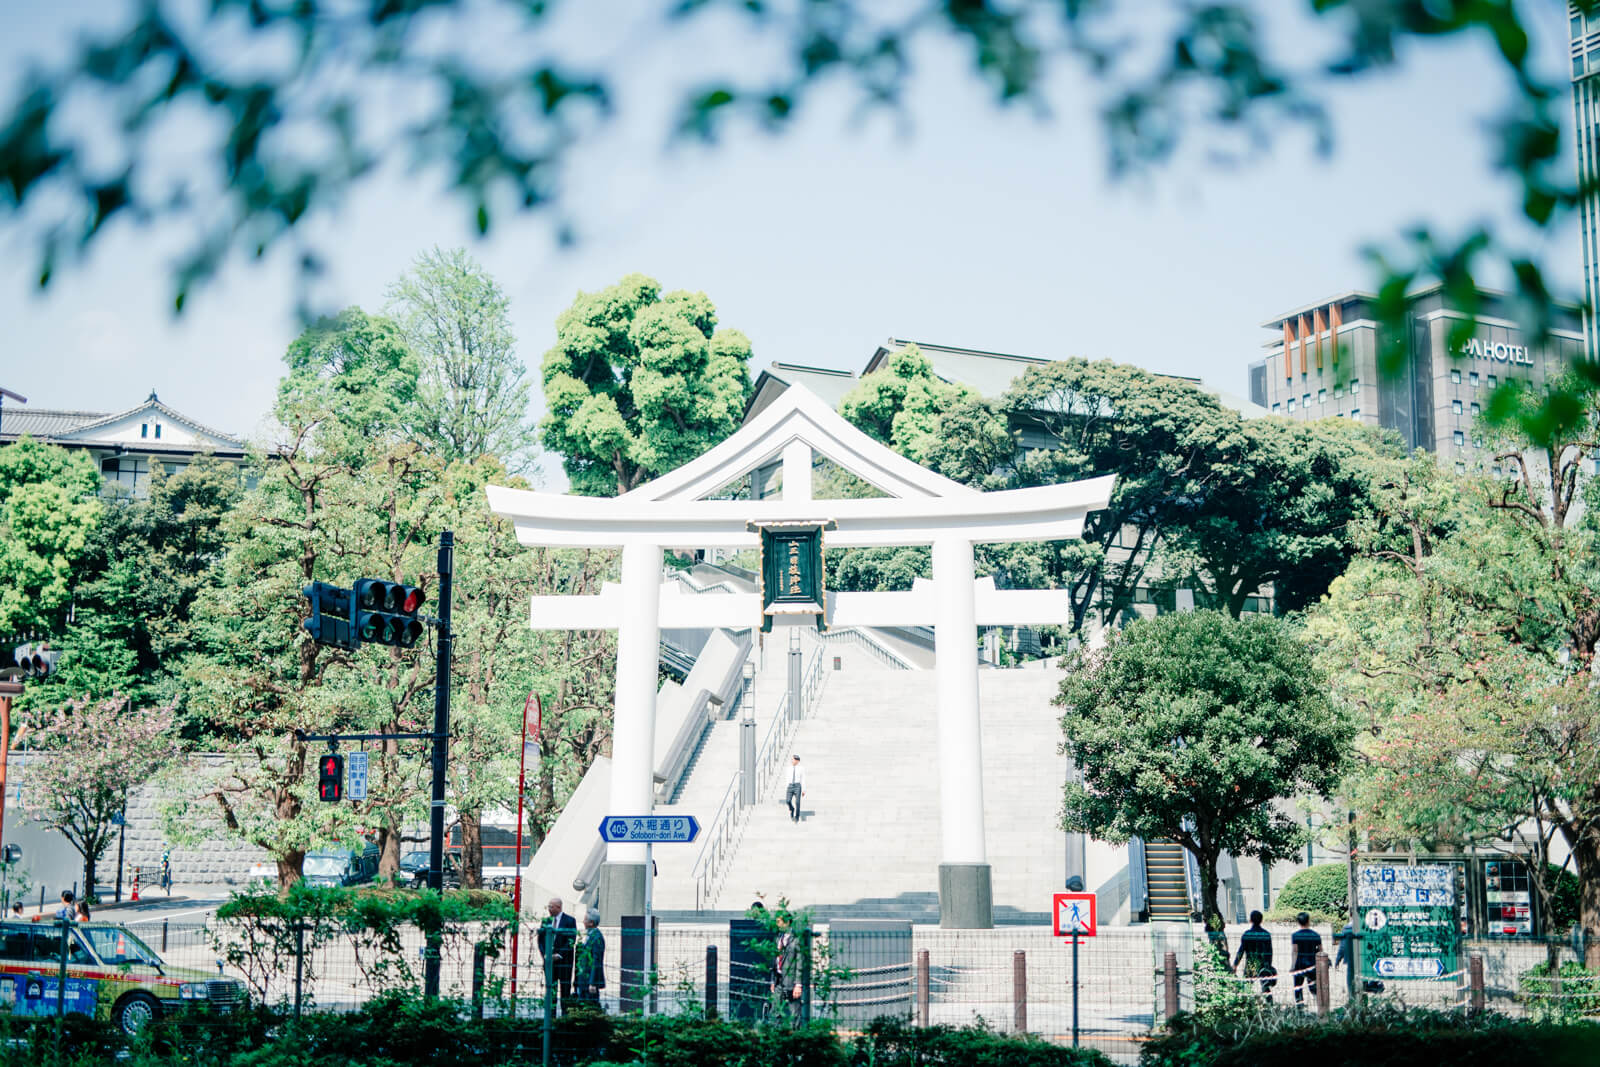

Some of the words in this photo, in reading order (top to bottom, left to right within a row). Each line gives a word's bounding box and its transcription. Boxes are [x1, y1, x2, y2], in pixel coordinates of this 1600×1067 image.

[1483, 340, 1534, 365] HOTEL
[611, 824, 627, 834] 405
[633, 819, 684, 831] 外堀通り
[673, 831, 686, 839] Ave.
